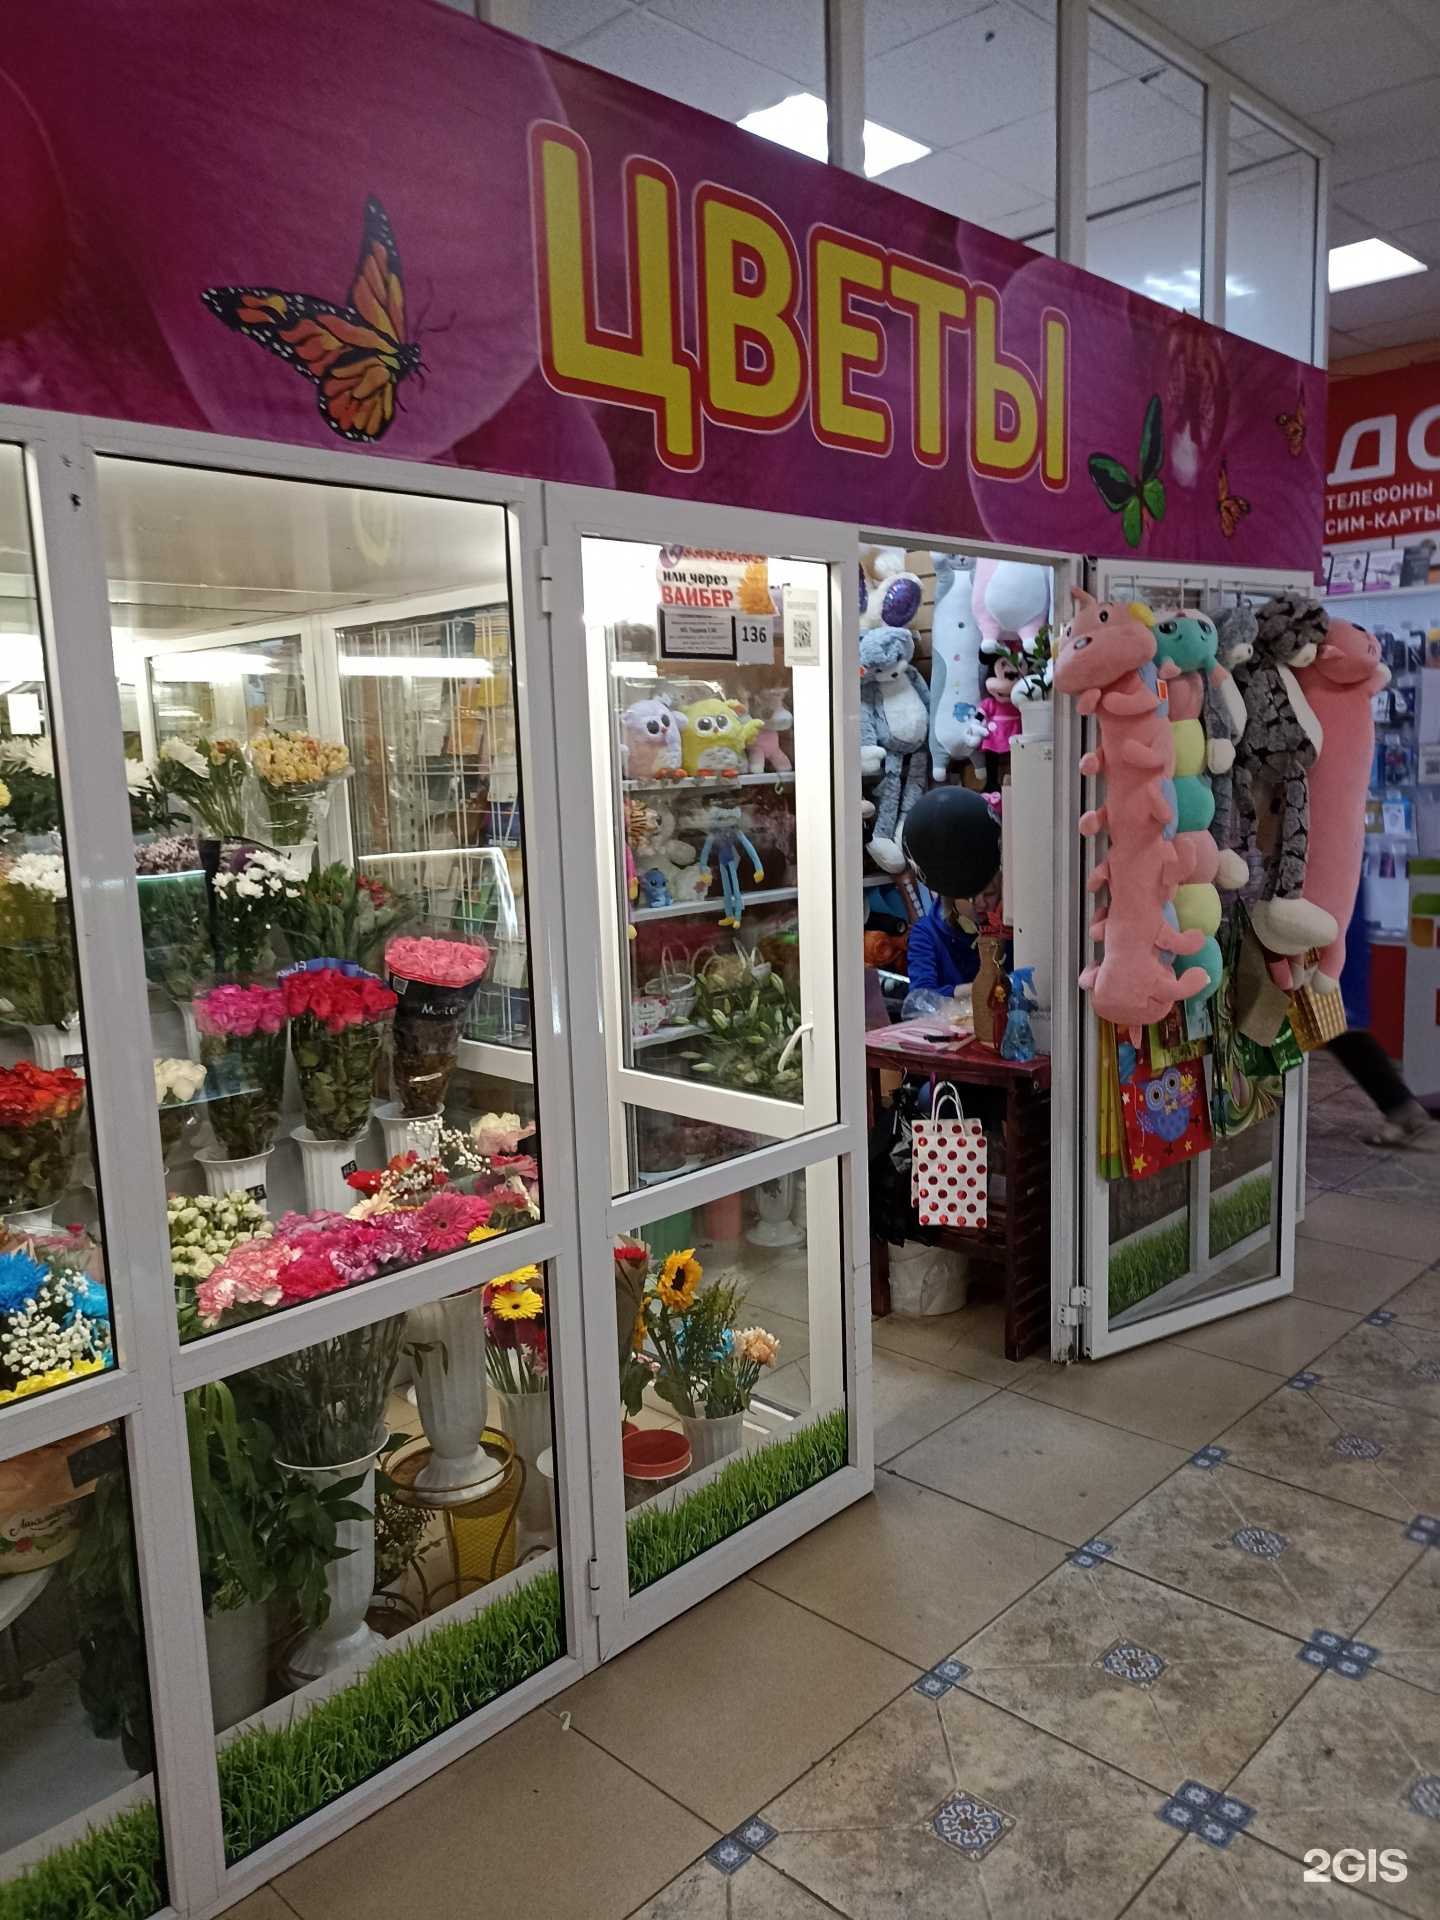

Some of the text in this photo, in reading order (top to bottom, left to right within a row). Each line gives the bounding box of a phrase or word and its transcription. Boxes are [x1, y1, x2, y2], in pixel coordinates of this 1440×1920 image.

[531, 121, 1069, 489] ЦВЕТЫ
[1326, 480, 1433, 511] ТЕЛЕФОНЫ
[690, 573, 728, 587] через
[741, 626, 767, 644] 136
